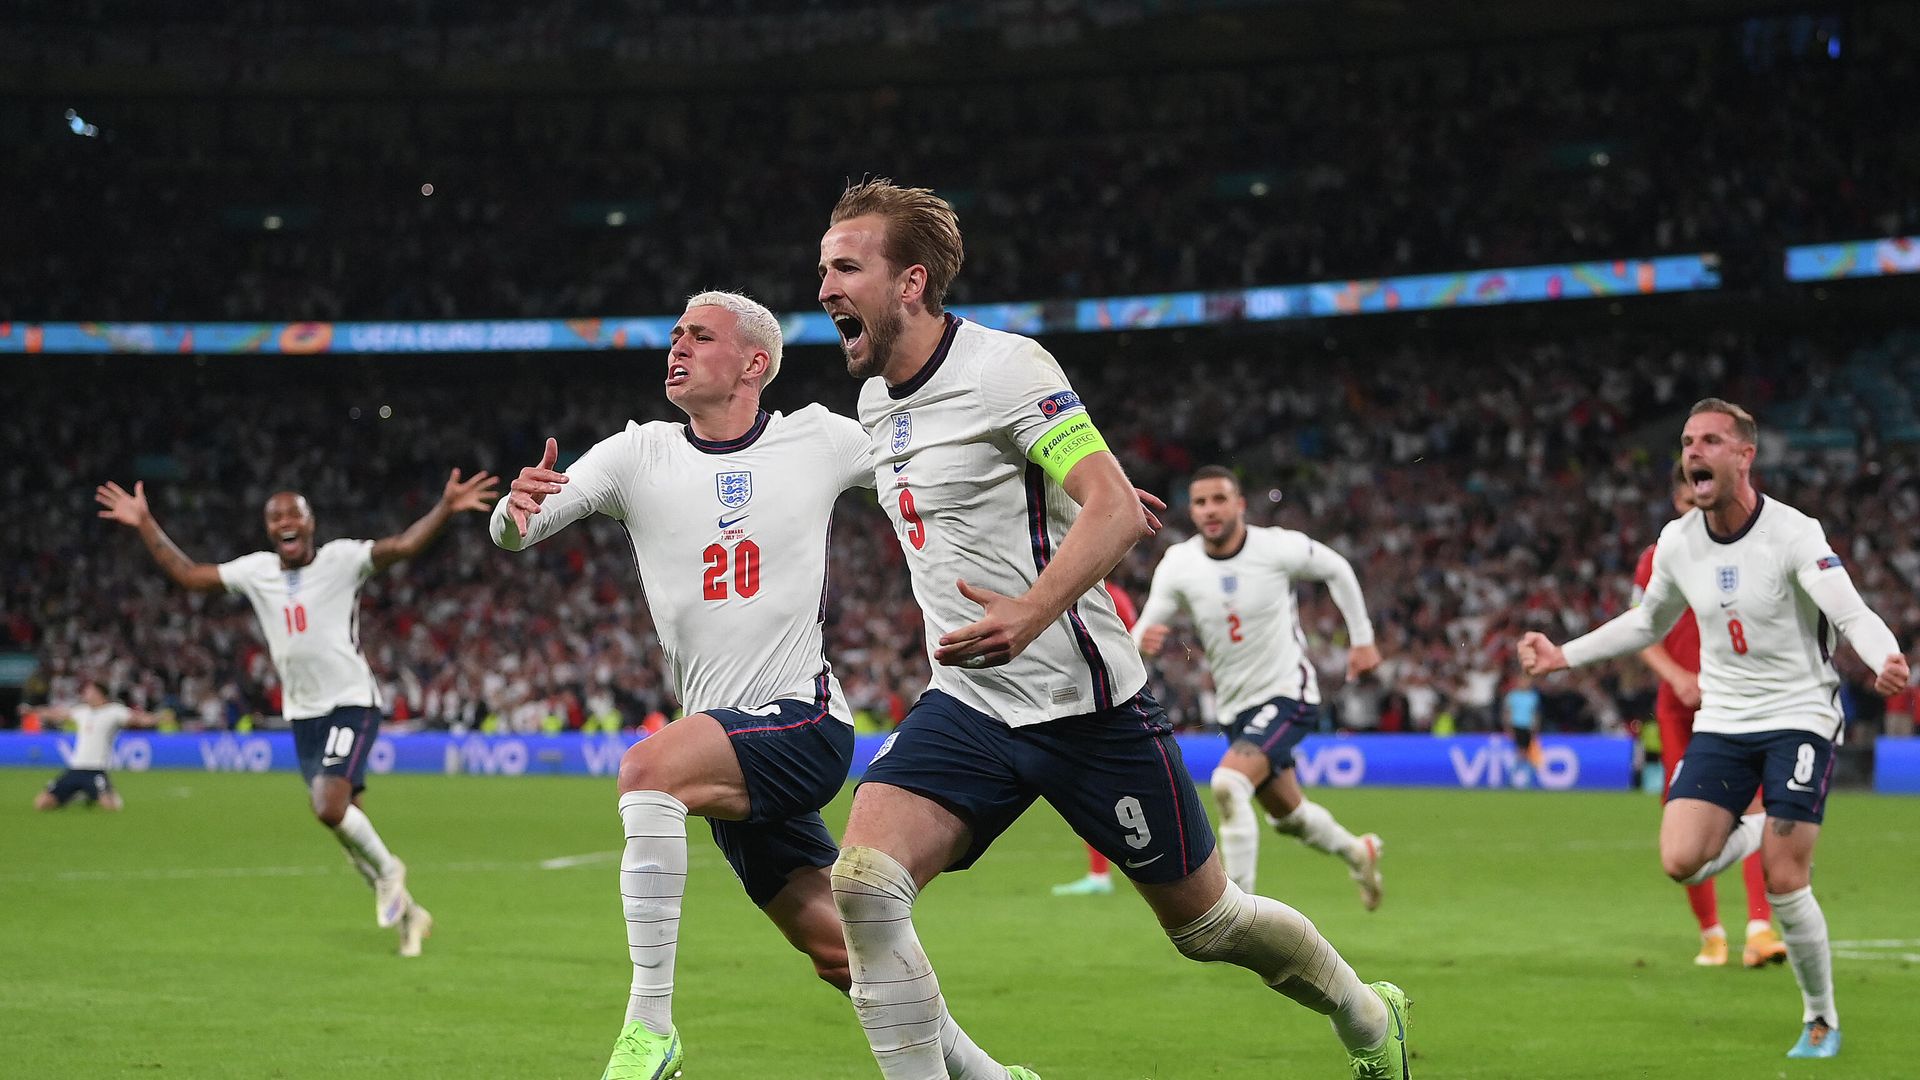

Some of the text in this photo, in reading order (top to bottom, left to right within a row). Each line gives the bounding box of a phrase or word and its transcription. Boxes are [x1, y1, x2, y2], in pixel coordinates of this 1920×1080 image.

[350, 322, 551, 351] UEFA EURO 2020
[1042, 430, 1070, 458] #EQUAL
[1062, 433, 1096, 455] RESPECT
[898, 488, 927, 550] 9
[702, 539, 761, 601] 20
[284, 604, 308, 636] 10
[1226, 613, 1243, 644] 2
[1728, 619, 1748, 656] 8
[325, 725, 355, 757] 10
[1794, 743, 1816, 784] 8
[1114, 796, 1151, 850] 9
